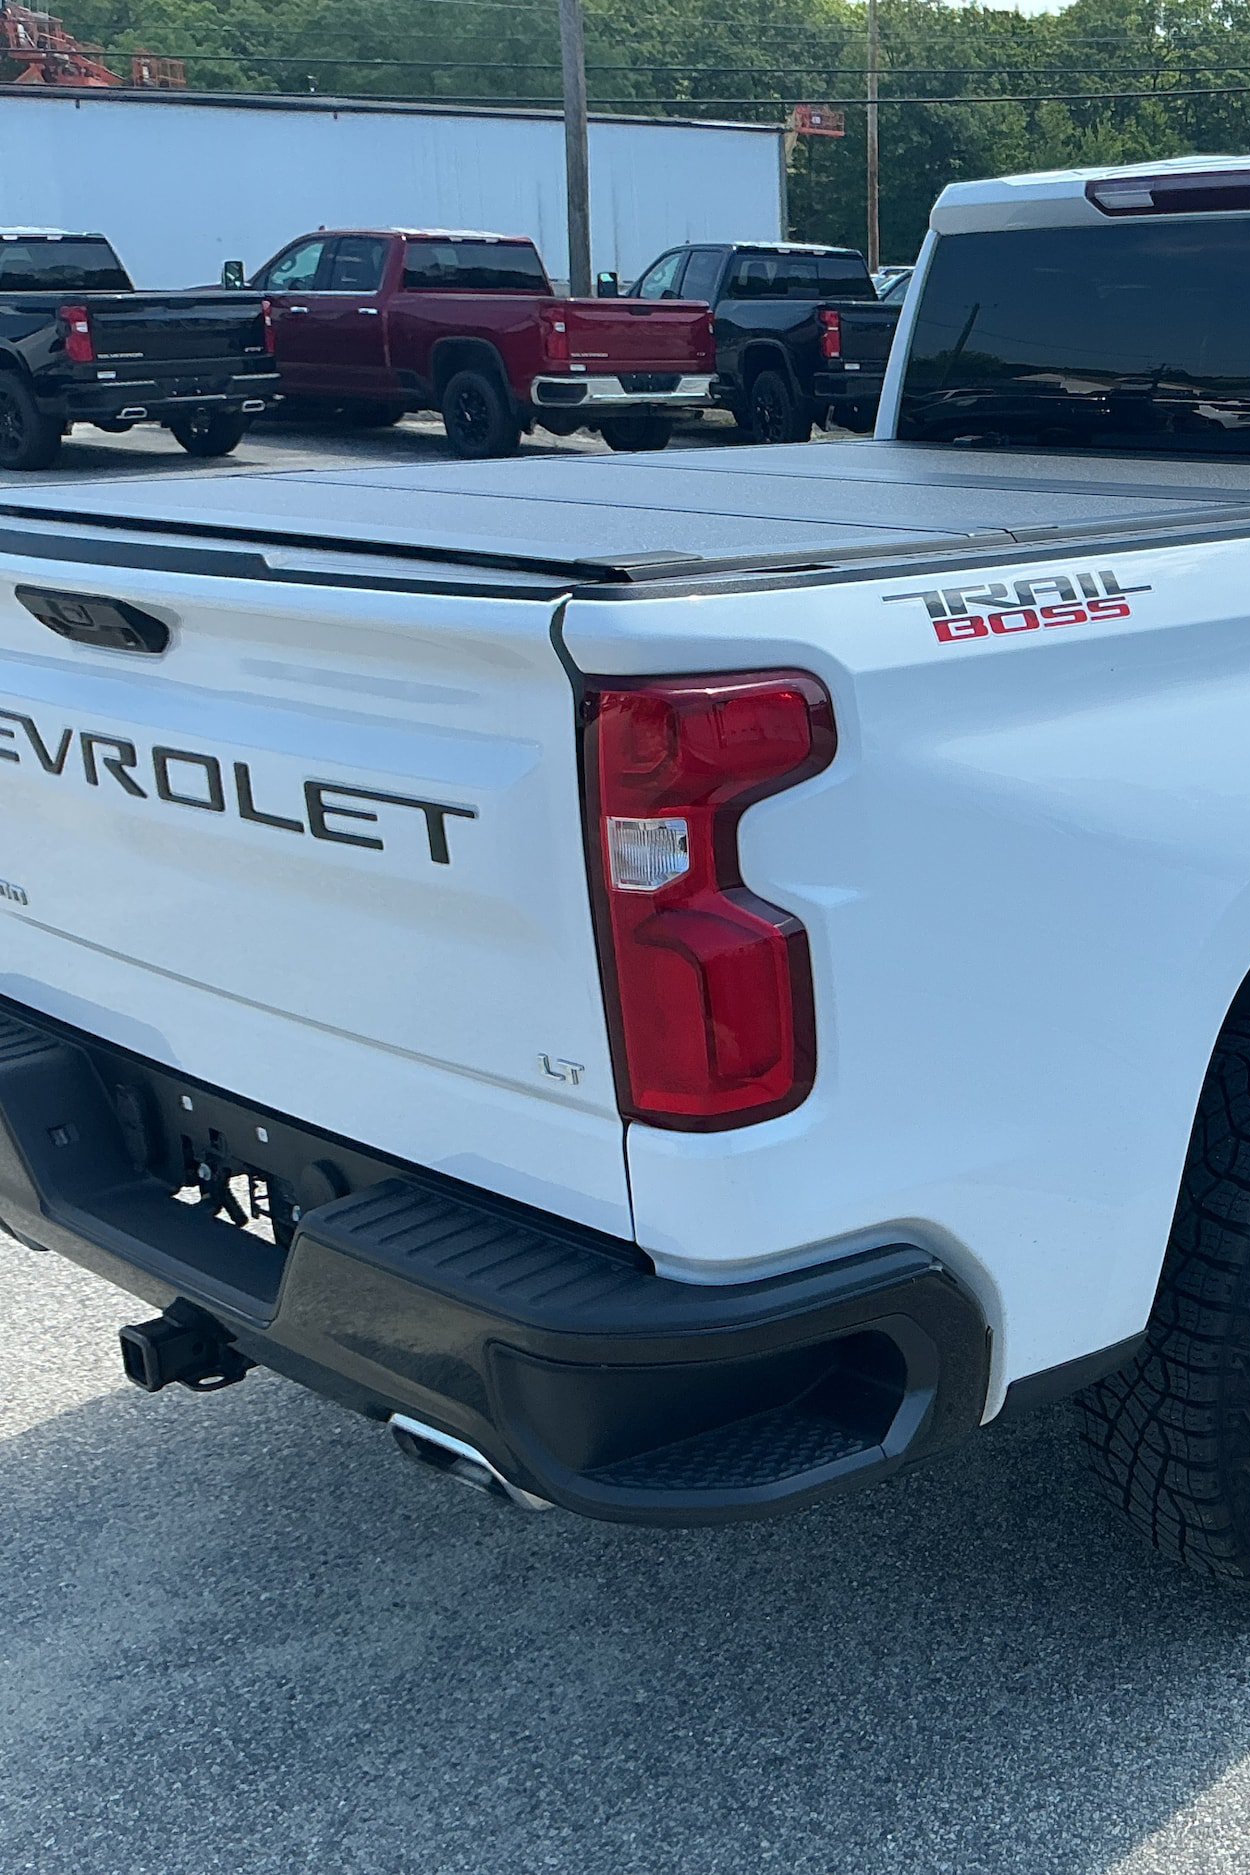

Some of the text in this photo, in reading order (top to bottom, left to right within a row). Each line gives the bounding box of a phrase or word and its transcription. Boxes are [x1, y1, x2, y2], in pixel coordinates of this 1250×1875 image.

[881, 569, 1153, 618] TRAIL
[932, 596, 1131, 642] BOSS
[536, 1052, 585, 1085] LT
